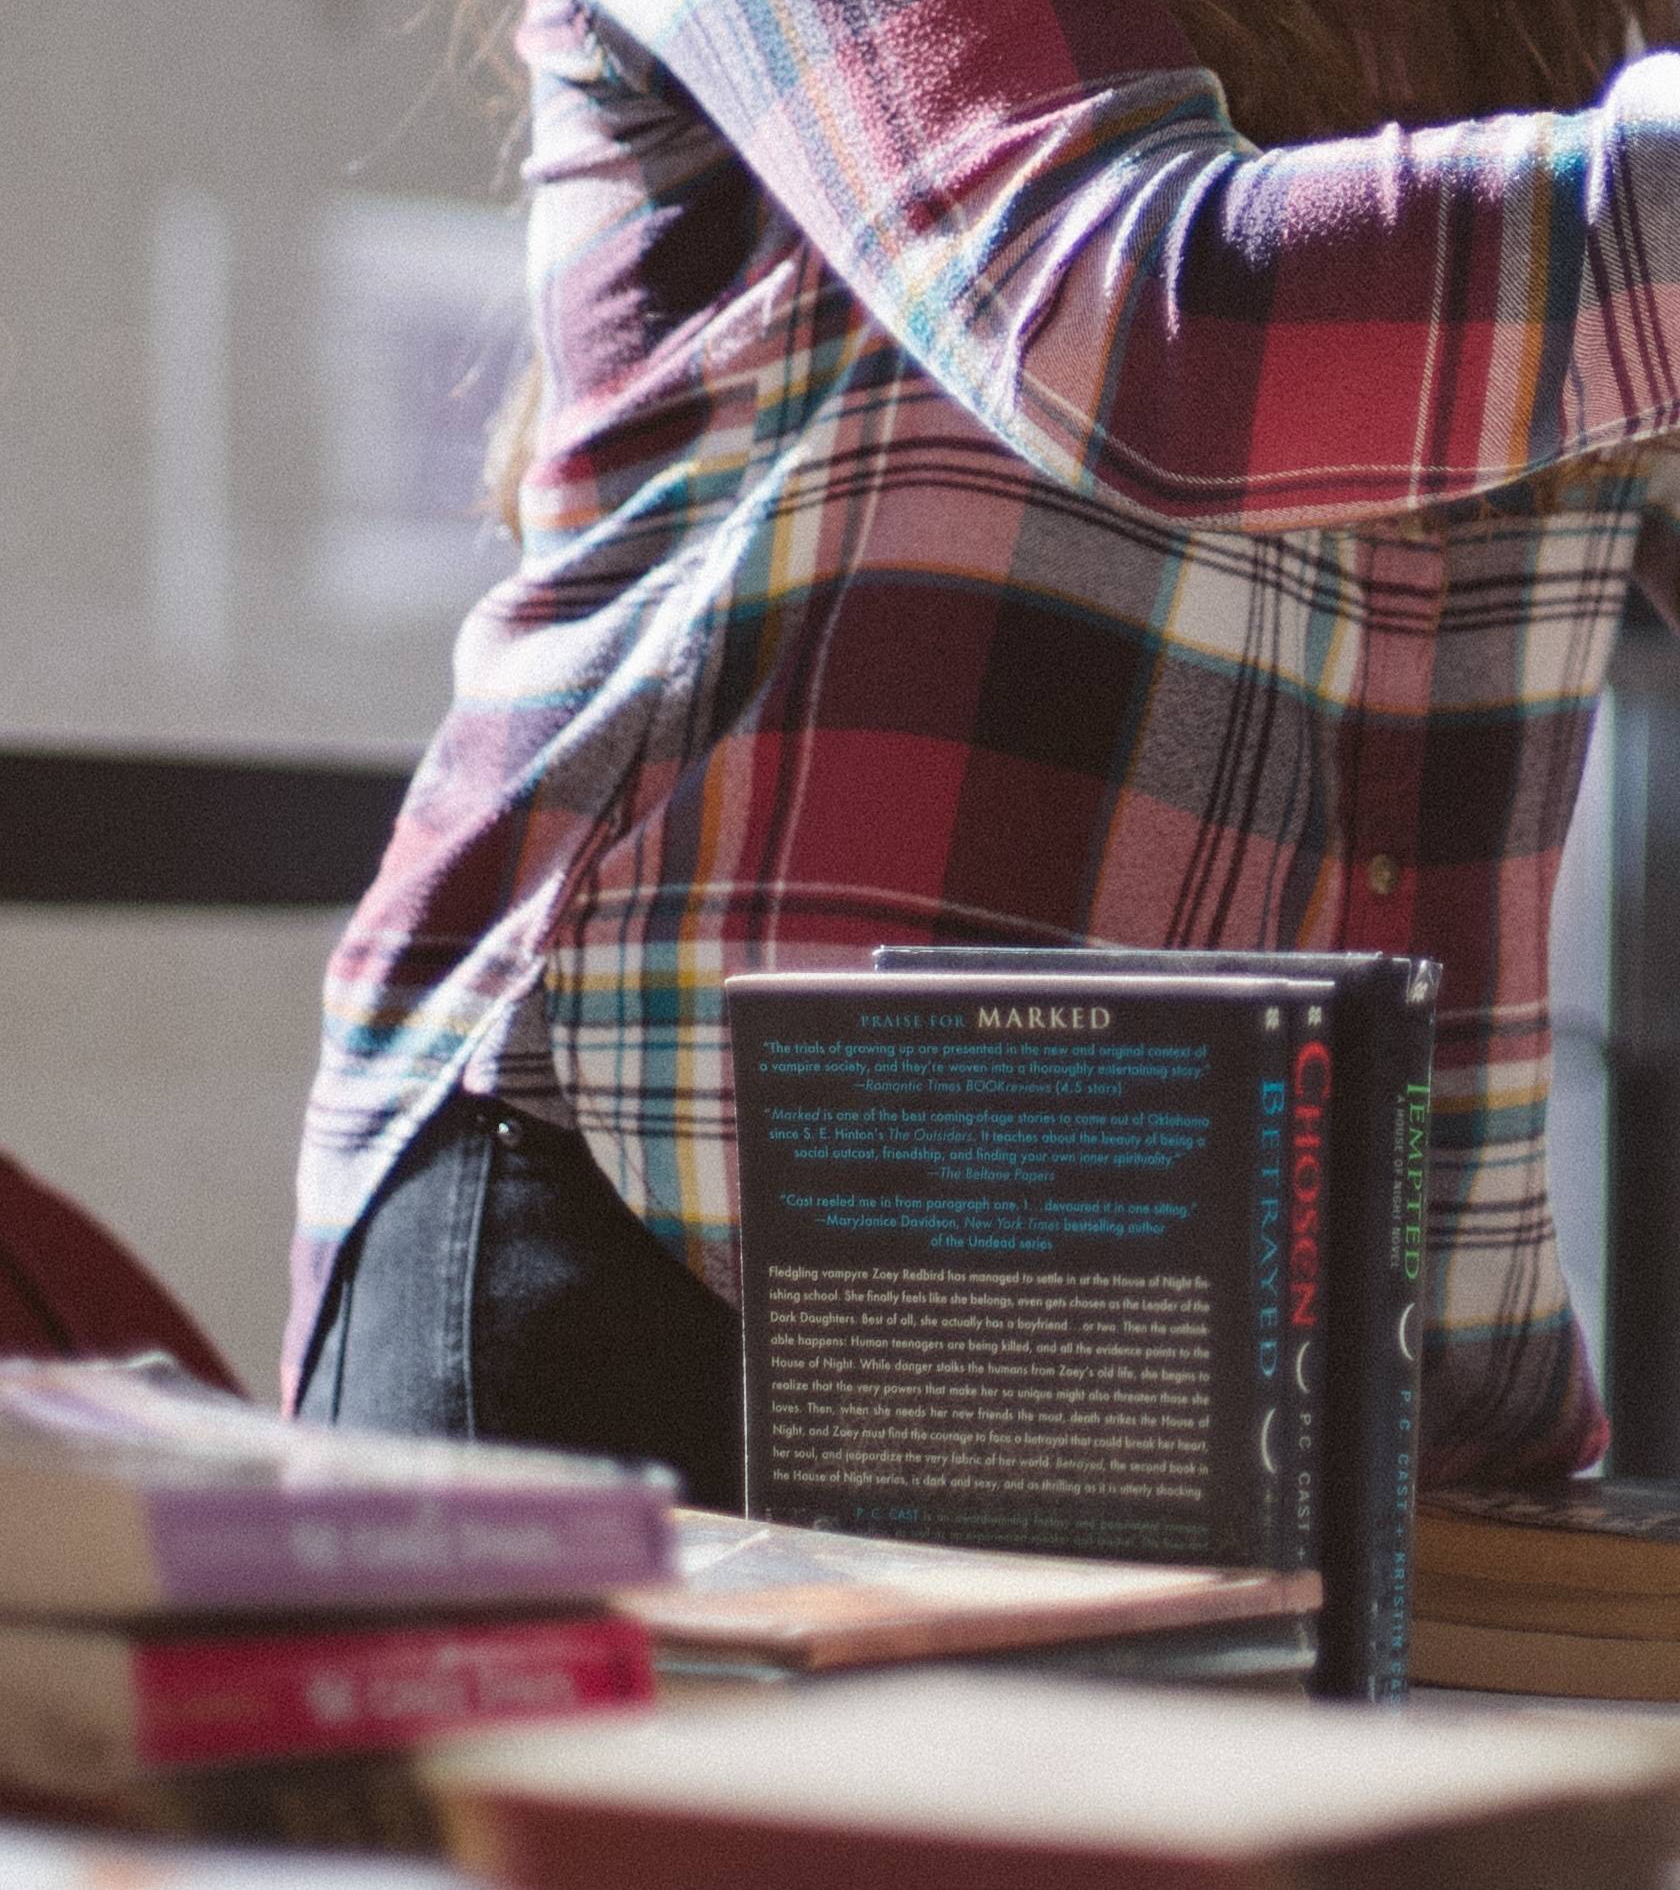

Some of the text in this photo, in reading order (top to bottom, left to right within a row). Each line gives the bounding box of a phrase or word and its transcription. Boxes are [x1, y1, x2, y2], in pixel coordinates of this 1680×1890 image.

[861, 1006, 1110, 1029] PRAISE FOR MARKED
[795, 1041, 824, 1054] trials
[829, 1040, 840, 1053] of
[845, 1042, 895, 1057] growing
[899, 1044, 914, 1057] up
[919, 1044, 938, 1055] are
[760, 1063, 767, 1072] a
[773, 1061, 820, 1073] vampire
[874, 1061, 897, 1072] and
[902, 1060, 944, 1073] they're
[928, 1079, 960, 1092] Times
[824, 1109, 832, 1120] is
[836, 1111, 858, 1121] one
[864, 1108, 875, 1121] of
[880, 1109, 896, 1121] the
[902, 1109, 926, 1122] best
[769, 1128, 799, 1140] since
[835, 1128, 884, 1140] Hinton's
[888, 1128, 908, 1141] The
[1393, 1109, 1405, 1152] HOUSE
[794, 1147, 828, 1158] social
[1394, 1159, 1403, 1176] OF
[1290, 1040, 1333, 1326] CHOSEN
[1405, 1083, 1430, 1280] TEMPTED
[817, 1194, 854, 1207] reeled
[860, 1198, 876, 1207] me
[881, 1195, 890, 1207] in
[895, 1195, 920, 1208] from
[1392, 1181, 1403, 1223] NIGHT
[1259, 1080, 1285, 1375] BETRAYED
[946, 1236, 963, 1247] the
[1390, 1227, 1401, 1268] NOVEL
[769, 1266, 818, 1280] Fledgling
[822, 1269, 868, 1281] vampyre
[872, 1269, 899, 1282] Zoey
[903, 1269, 944, 1281] Redbird
[770, 1289, 800, 1302] ishing
[845, 1290, 863, 1302] She
[867, 1291, 899, 1305] finally
[902, 1291, 926, 1303] feels
[929, 1293, 947, 1304] like
[770, 1312, 795, 1323] Dark
[862, 1313, 883, 1324] Best
[887, 1313, 896, 1325] of
[921, 1315, 937, 1326] she
[771, 1335, 794, 1345] able
[851, 1336, 888, 1347] Human
[892, 1338, 943, 1352] teenagers
[772, 1357, 804, 1368] House
[809, 1357, 819, 1368] of
[860, 1358, 890, 1370] While
[895, 1360, 932, 1374] danger
[937, 1361, 964, 1372] stalks
[772, 1379, 808, 1391] realize
[812, 1380, 833, 1391] that
[837, 1380, 853, 1391] the
[857, 1384, 880, 1395] very
[884, 1384, 921, 1396] powers
[926, 1384, 945, 1394] that
[841, 1404, 869, 1415] when
[874, 1404, 890, 1415] she
[896, 1405, 926, 1417] needs
[931, 1406, 948, 1417] her
[809, 1426, 828, 1436] and
[833, 1427, 859, 1440] Zoey
[862, 1428, 885, 1438] must
[889, 1427, 908, 1438] find
[911, 1428, 927, 1439] the
[930, 1431, 972, 1444] courage
[773, 1447, 790, 1458] her
[822, 1449, 842, 1459] and
[846, 1450, 902, 1463] jeopardize
[906, 1450, 921, 1462] the
[925, 1453, 947, 1467] very
[773, 1470, 789, 1480] the
[794, 1471, 825, 1481] House
[830, 1471, 840, 1482] of
[844, 1472, 872, 1485] Night
[912, 1474, 920, 1485] is
[923, 1474, 946, 1486] dark
[1396, 1453, 1410, 1511] CAST
[1297, 1472, 1312, 1532] CAST
[1391, 1551, 1406, 1648] KRISTIN
[1389, 1662, 1403, 1708] CAS
